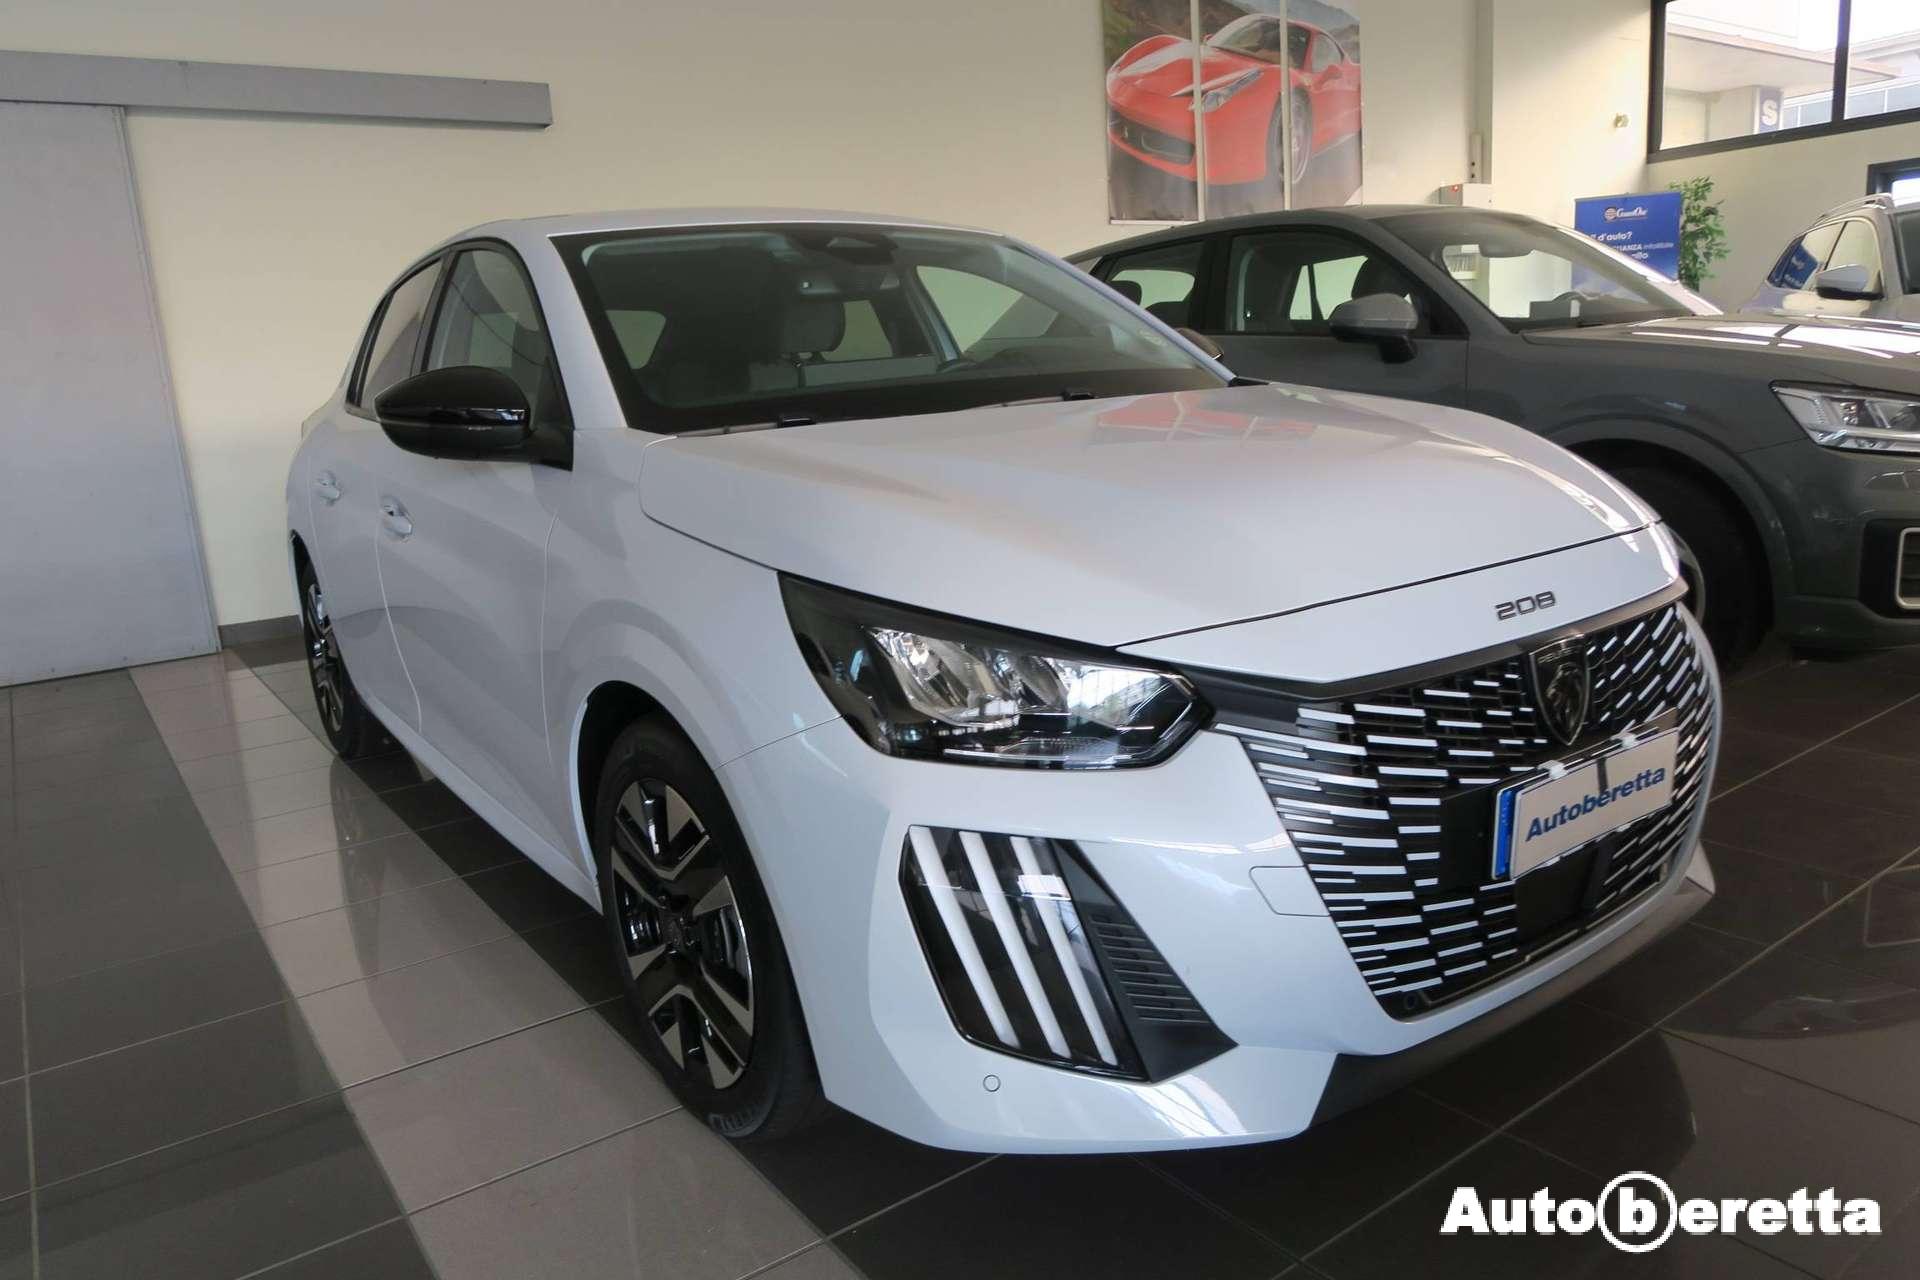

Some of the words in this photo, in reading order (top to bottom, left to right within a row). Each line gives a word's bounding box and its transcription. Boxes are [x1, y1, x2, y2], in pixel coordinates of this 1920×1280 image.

[1762, 99, 1778, 126] S
[1495, 590, 1556, 621] 208
[1525, 767, 1666, 842] Autoberetta
